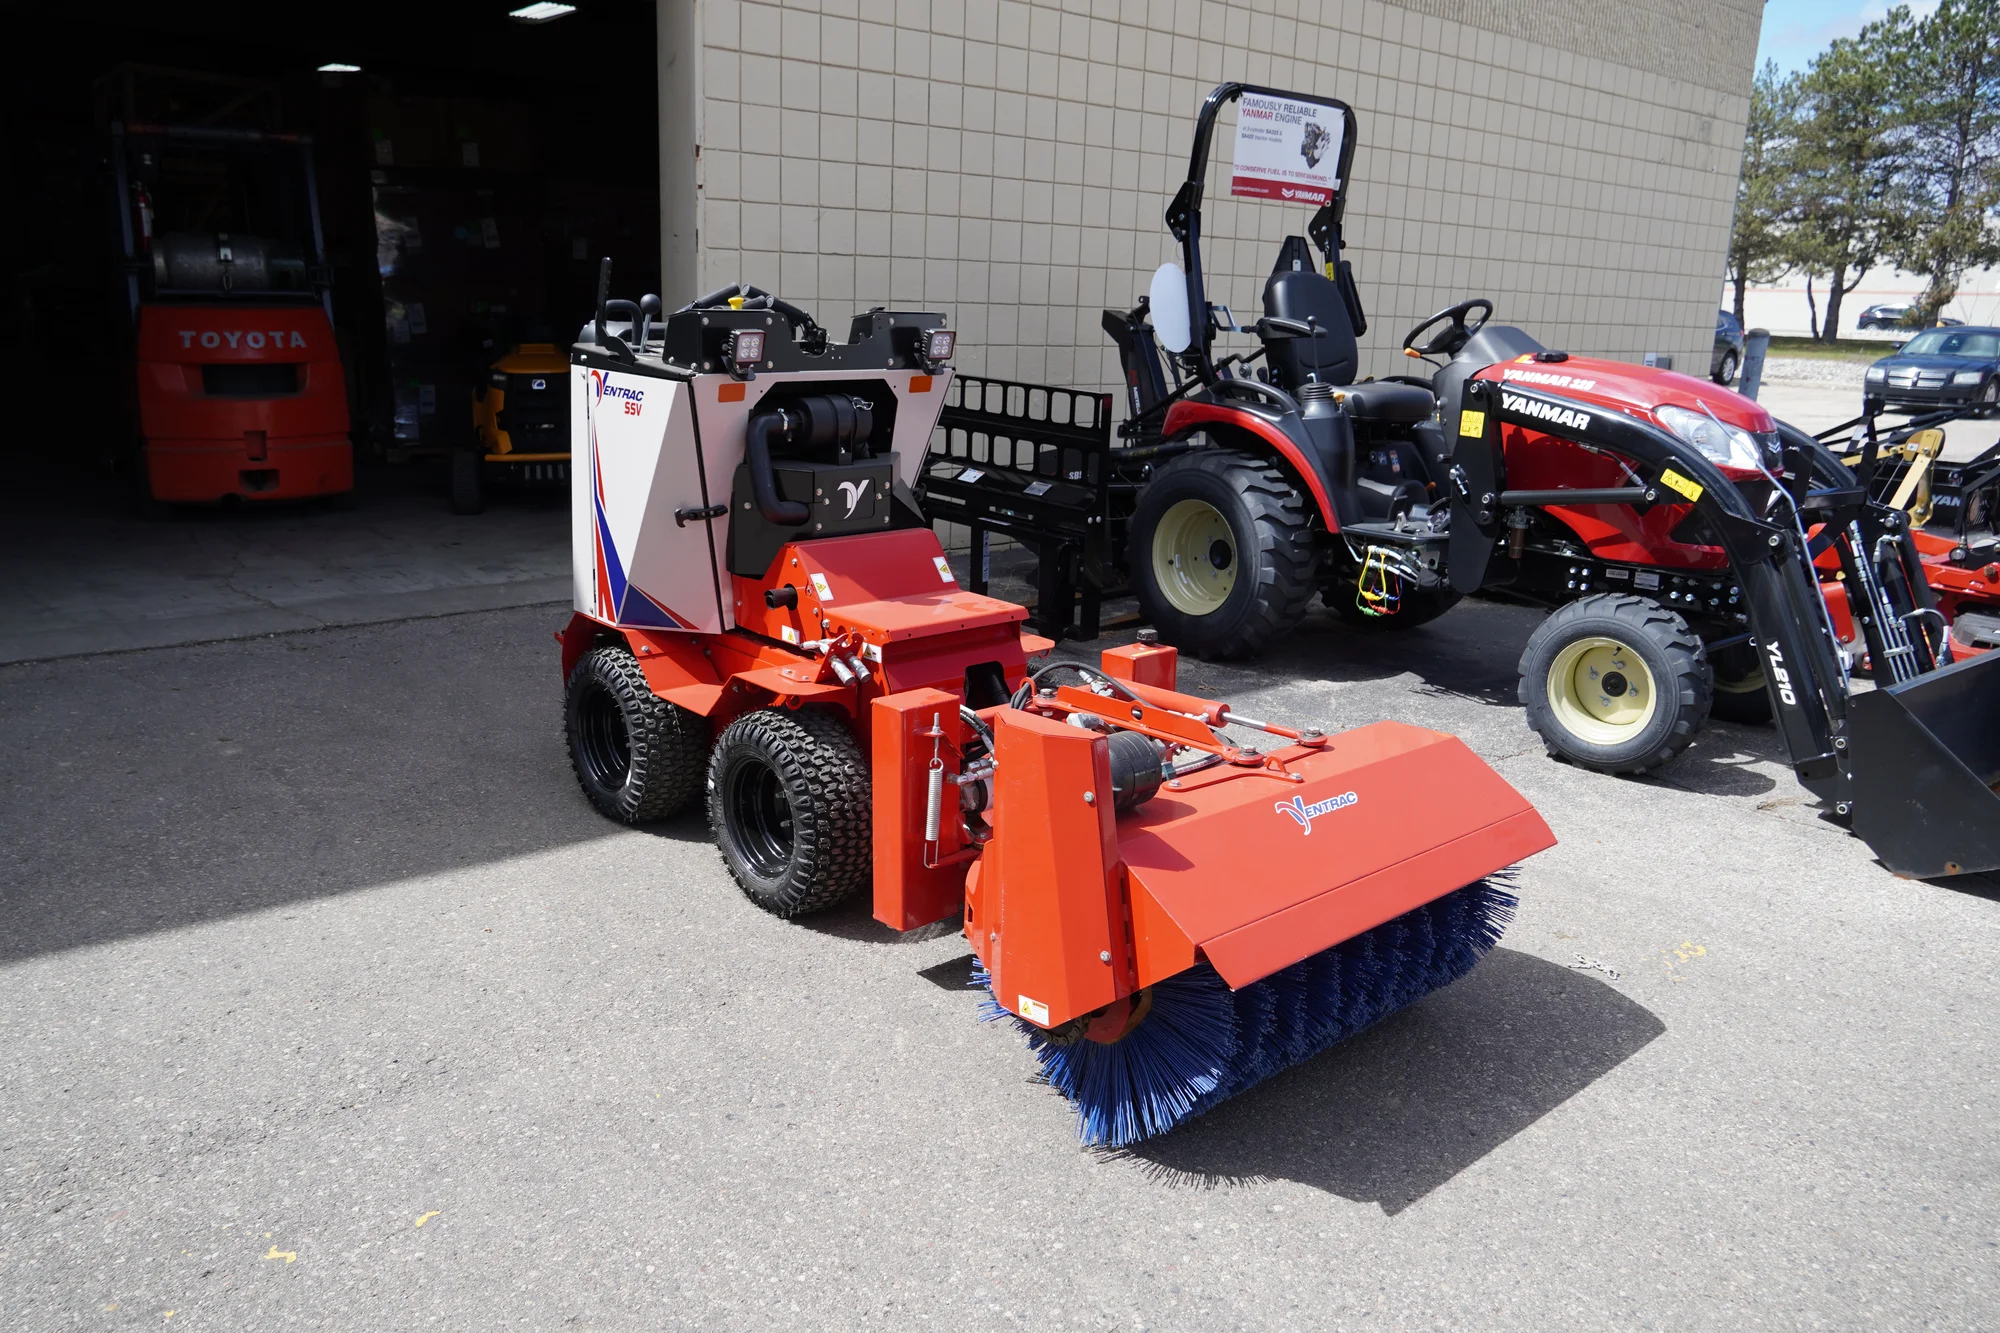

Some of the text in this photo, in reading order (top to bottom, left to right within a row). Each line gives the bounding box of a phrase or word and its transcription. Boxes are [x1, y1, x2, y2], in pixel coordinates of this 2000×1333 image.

[1242, 98, 1318, 118] FAMOUSLY RELIABLE
[1242, 108, 1303, 125] YANMAR ENGINE
[1240, 165, 1267, 174] CONSERVE
[1267, 168, 1280, 176] FUEL
[1294, 189, 1326, 202] YANMAR
[178, 331, 308, 349] TOYOTA
[1502, 368, 1572, 387] YANMAR
[591, 369, 644, 408] VENTRAC
[624, 401, 642, 417] SSV
[1502, 392, 1591, 431] YANMAR
[1766, 640, 1797, 706] YL210
[1274, 791, 1358, 836] VENTRAC
